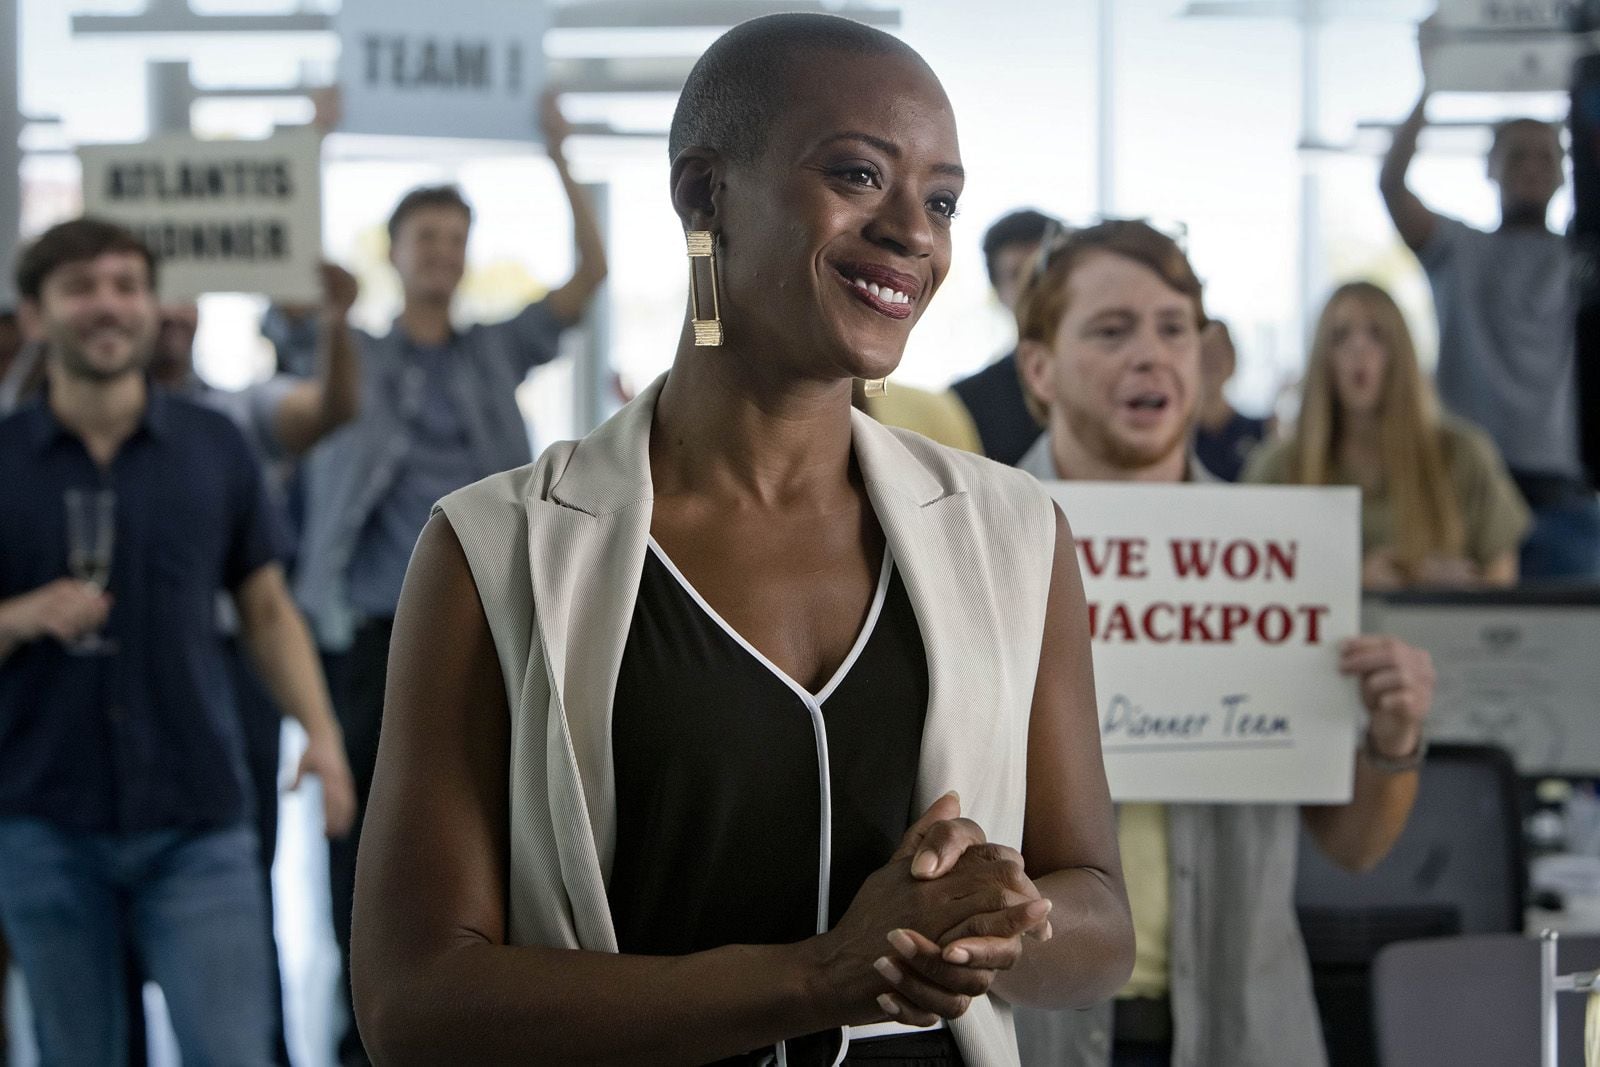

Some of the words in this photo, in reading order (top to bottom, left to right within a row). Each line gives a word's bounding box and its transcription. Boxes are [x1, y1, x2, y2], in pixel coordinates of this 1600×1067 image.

[359, 30, 491, 91] TEAM
[106, 160, 293, 202] ATLANTIS
[1170, 538, 1299, 580] WON
[1088, 602, 1329, 645] JACKPOT
[1220, 693, 1291, 737] Team
